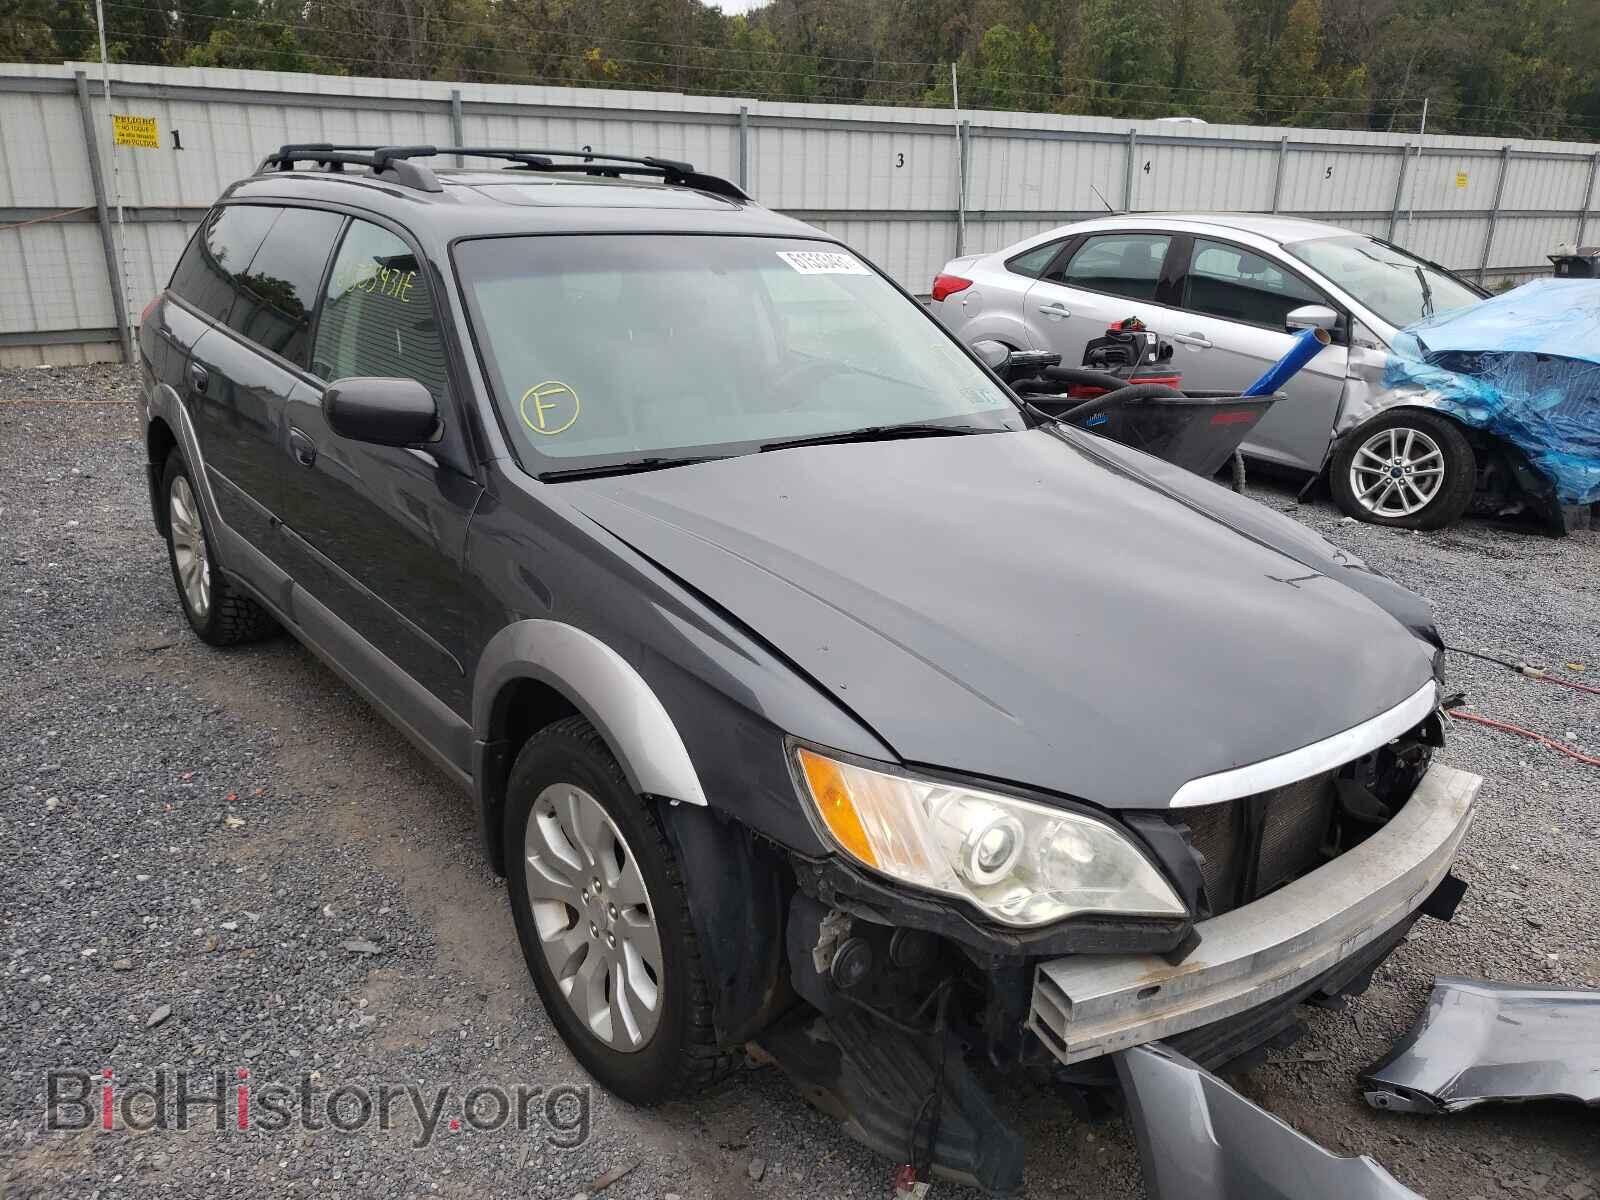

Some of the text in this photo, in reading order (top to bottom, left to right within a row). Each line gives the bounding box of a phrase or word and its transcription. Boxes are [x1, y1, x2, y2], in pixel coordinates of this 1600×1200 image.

[171, 129, 185, 151] 1
[895, 152, 905, 169] 3
[1143, 160, 1151, 175] 4
[1325, 166, 1333, 180] 5
